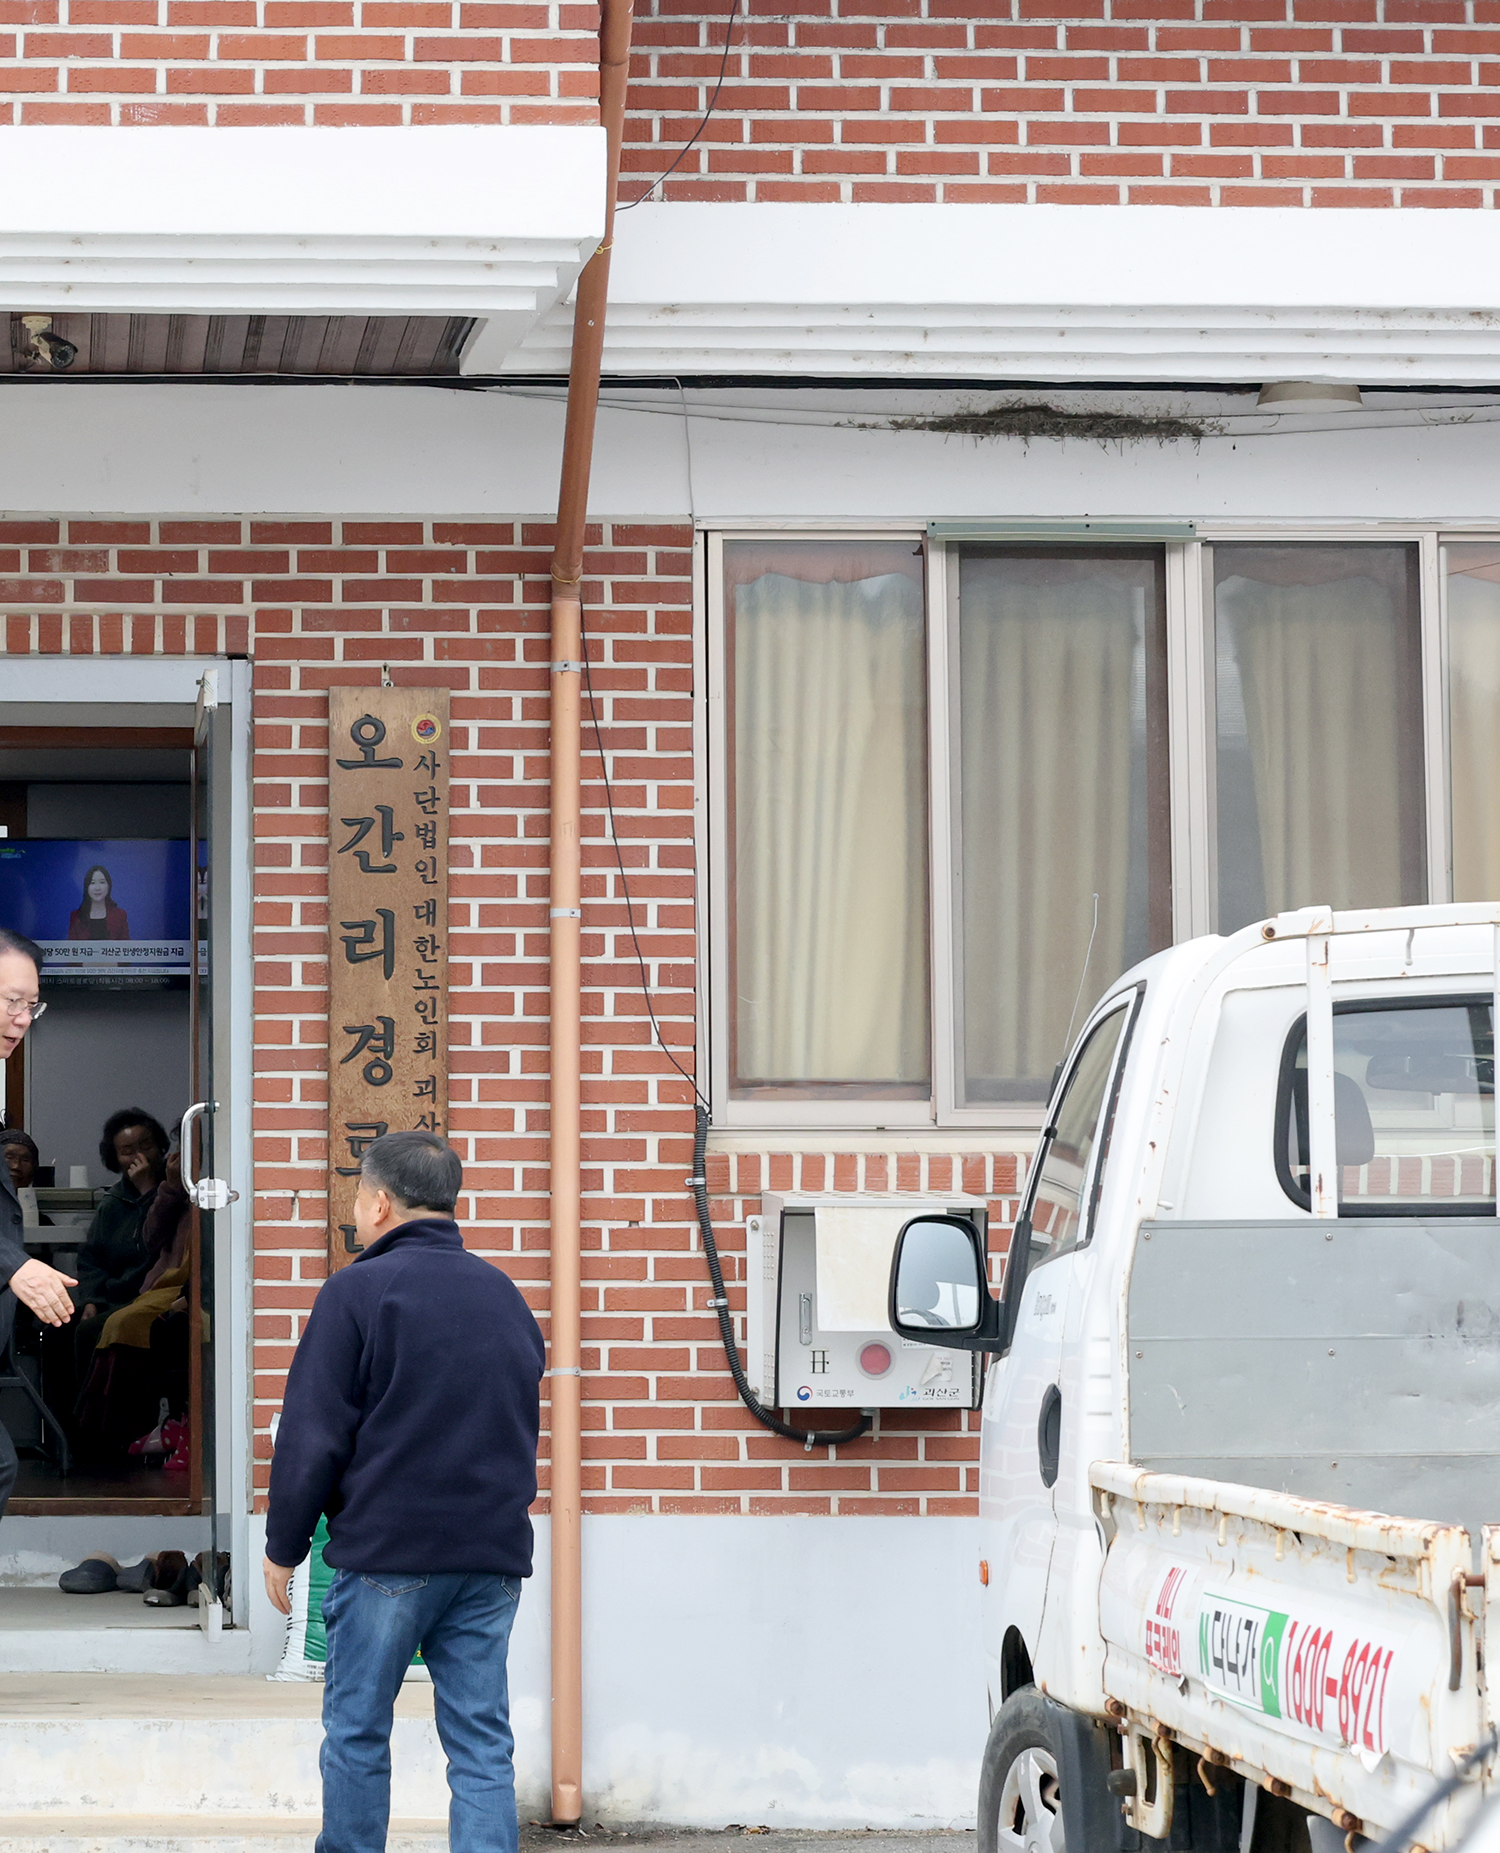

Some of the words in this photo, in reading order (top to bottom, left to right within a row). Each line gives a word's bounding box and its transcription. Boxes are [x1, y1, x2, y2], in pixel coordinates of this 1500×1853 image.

[413, 750, 441, 884] 사단법인
[101, 948, 121, 956] 괴산군
[171, 947, 184, 956] 지급
[336, 714, 405, 1254] 오간리경로
[412, 899, 440, 1059] 대한노인회
[923, 1388, 959, 1397] 괴산군
[1285, 1621, 1394, 1753] 1600-8921
